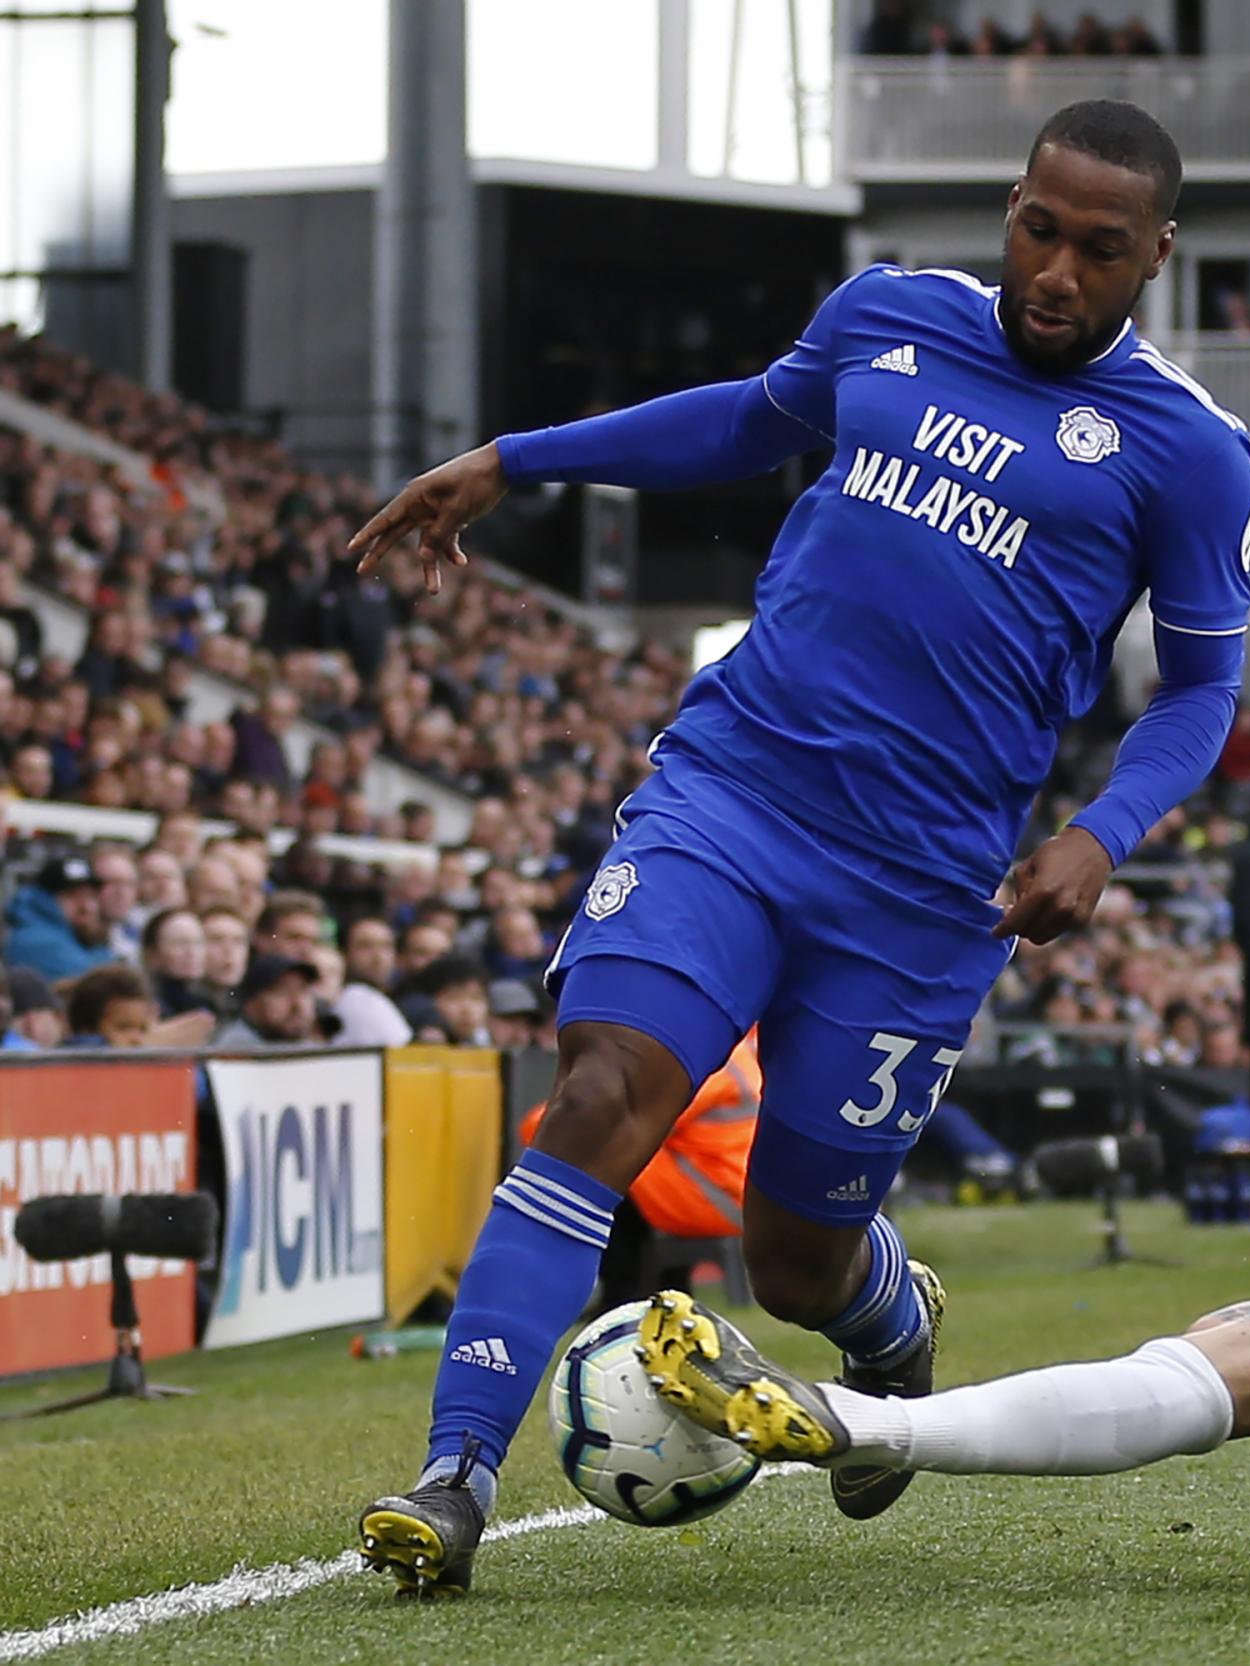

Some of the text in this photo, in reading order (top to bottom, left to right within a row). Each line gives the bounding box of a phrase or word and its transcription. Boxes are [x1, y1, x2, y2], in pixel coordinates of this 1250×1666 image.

[912, 404, 1025, 483] VISIT
[841, 447, 1031, 569] MALAYSIA
[450, 1350, 518, 1376] adidas
